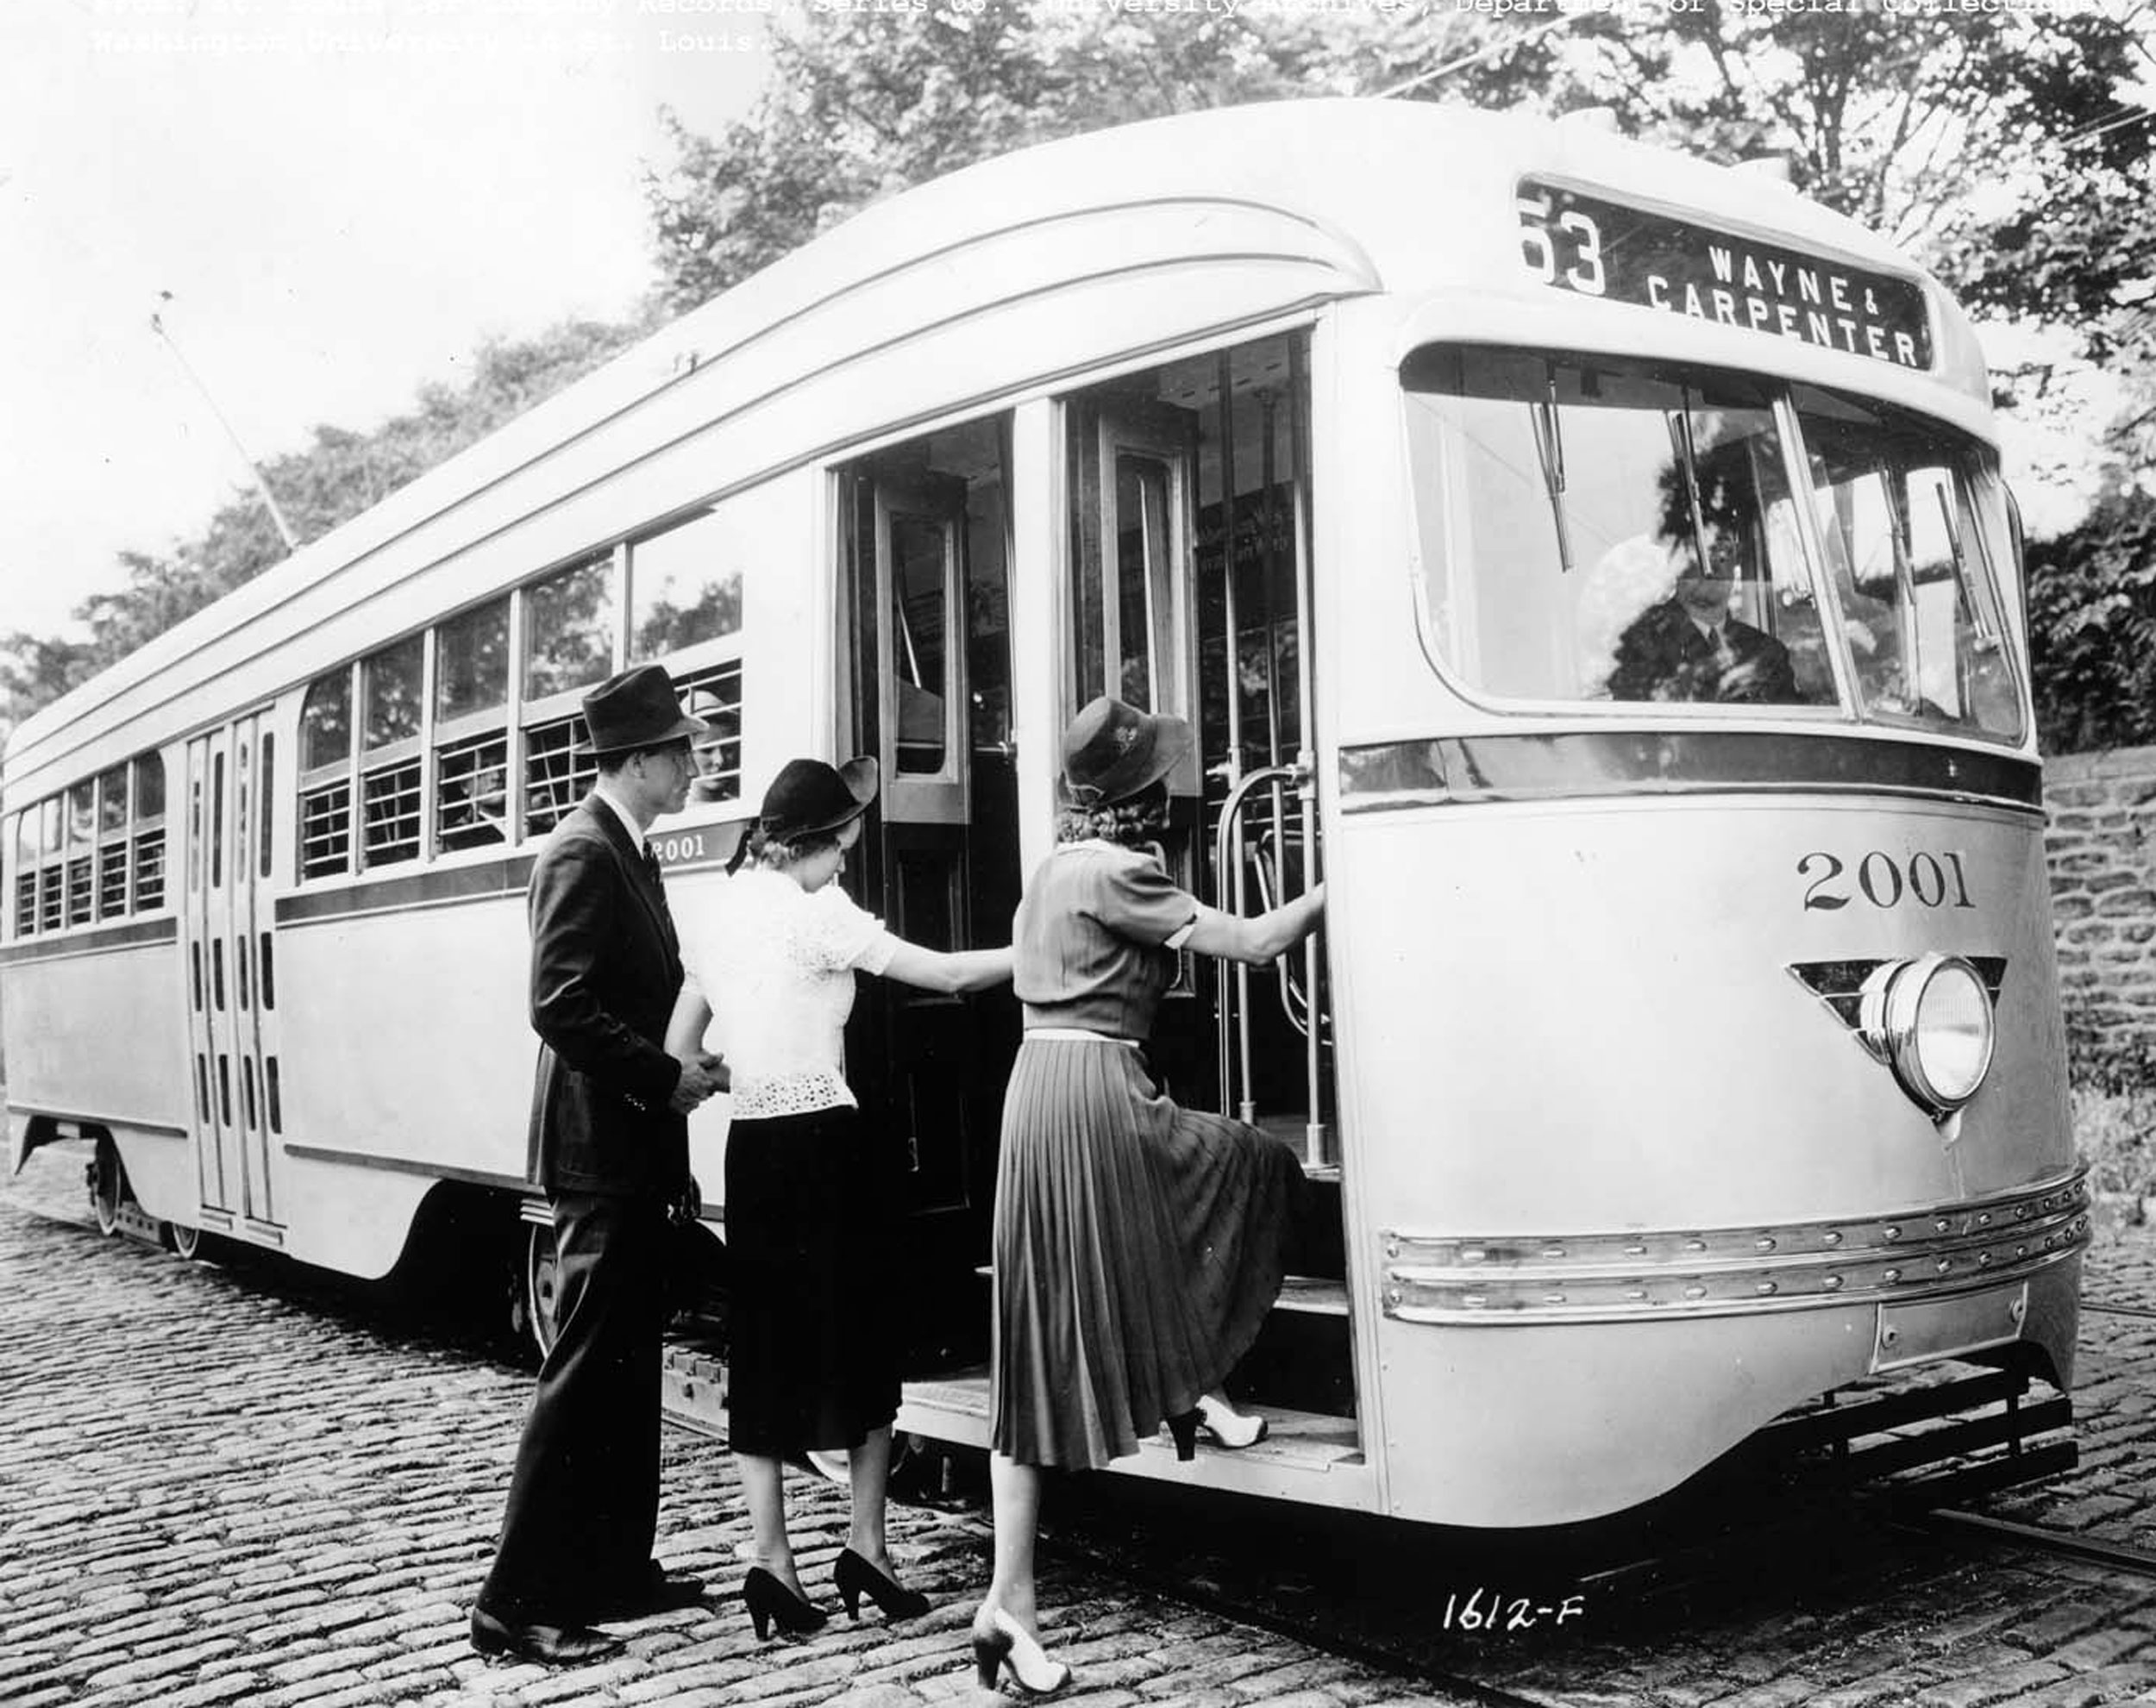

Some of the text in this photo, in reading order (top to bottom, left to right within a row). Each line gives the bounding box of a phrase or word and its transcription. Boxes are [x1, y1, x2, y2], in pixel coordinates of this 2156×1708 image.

[1517, 197, 1607, 296] 53
[1709, 246, 1880, 316] WAYNE &
[1648, 275, 1918, 367] CARPENTER
[1797, 851, 1976, 911] 2001
